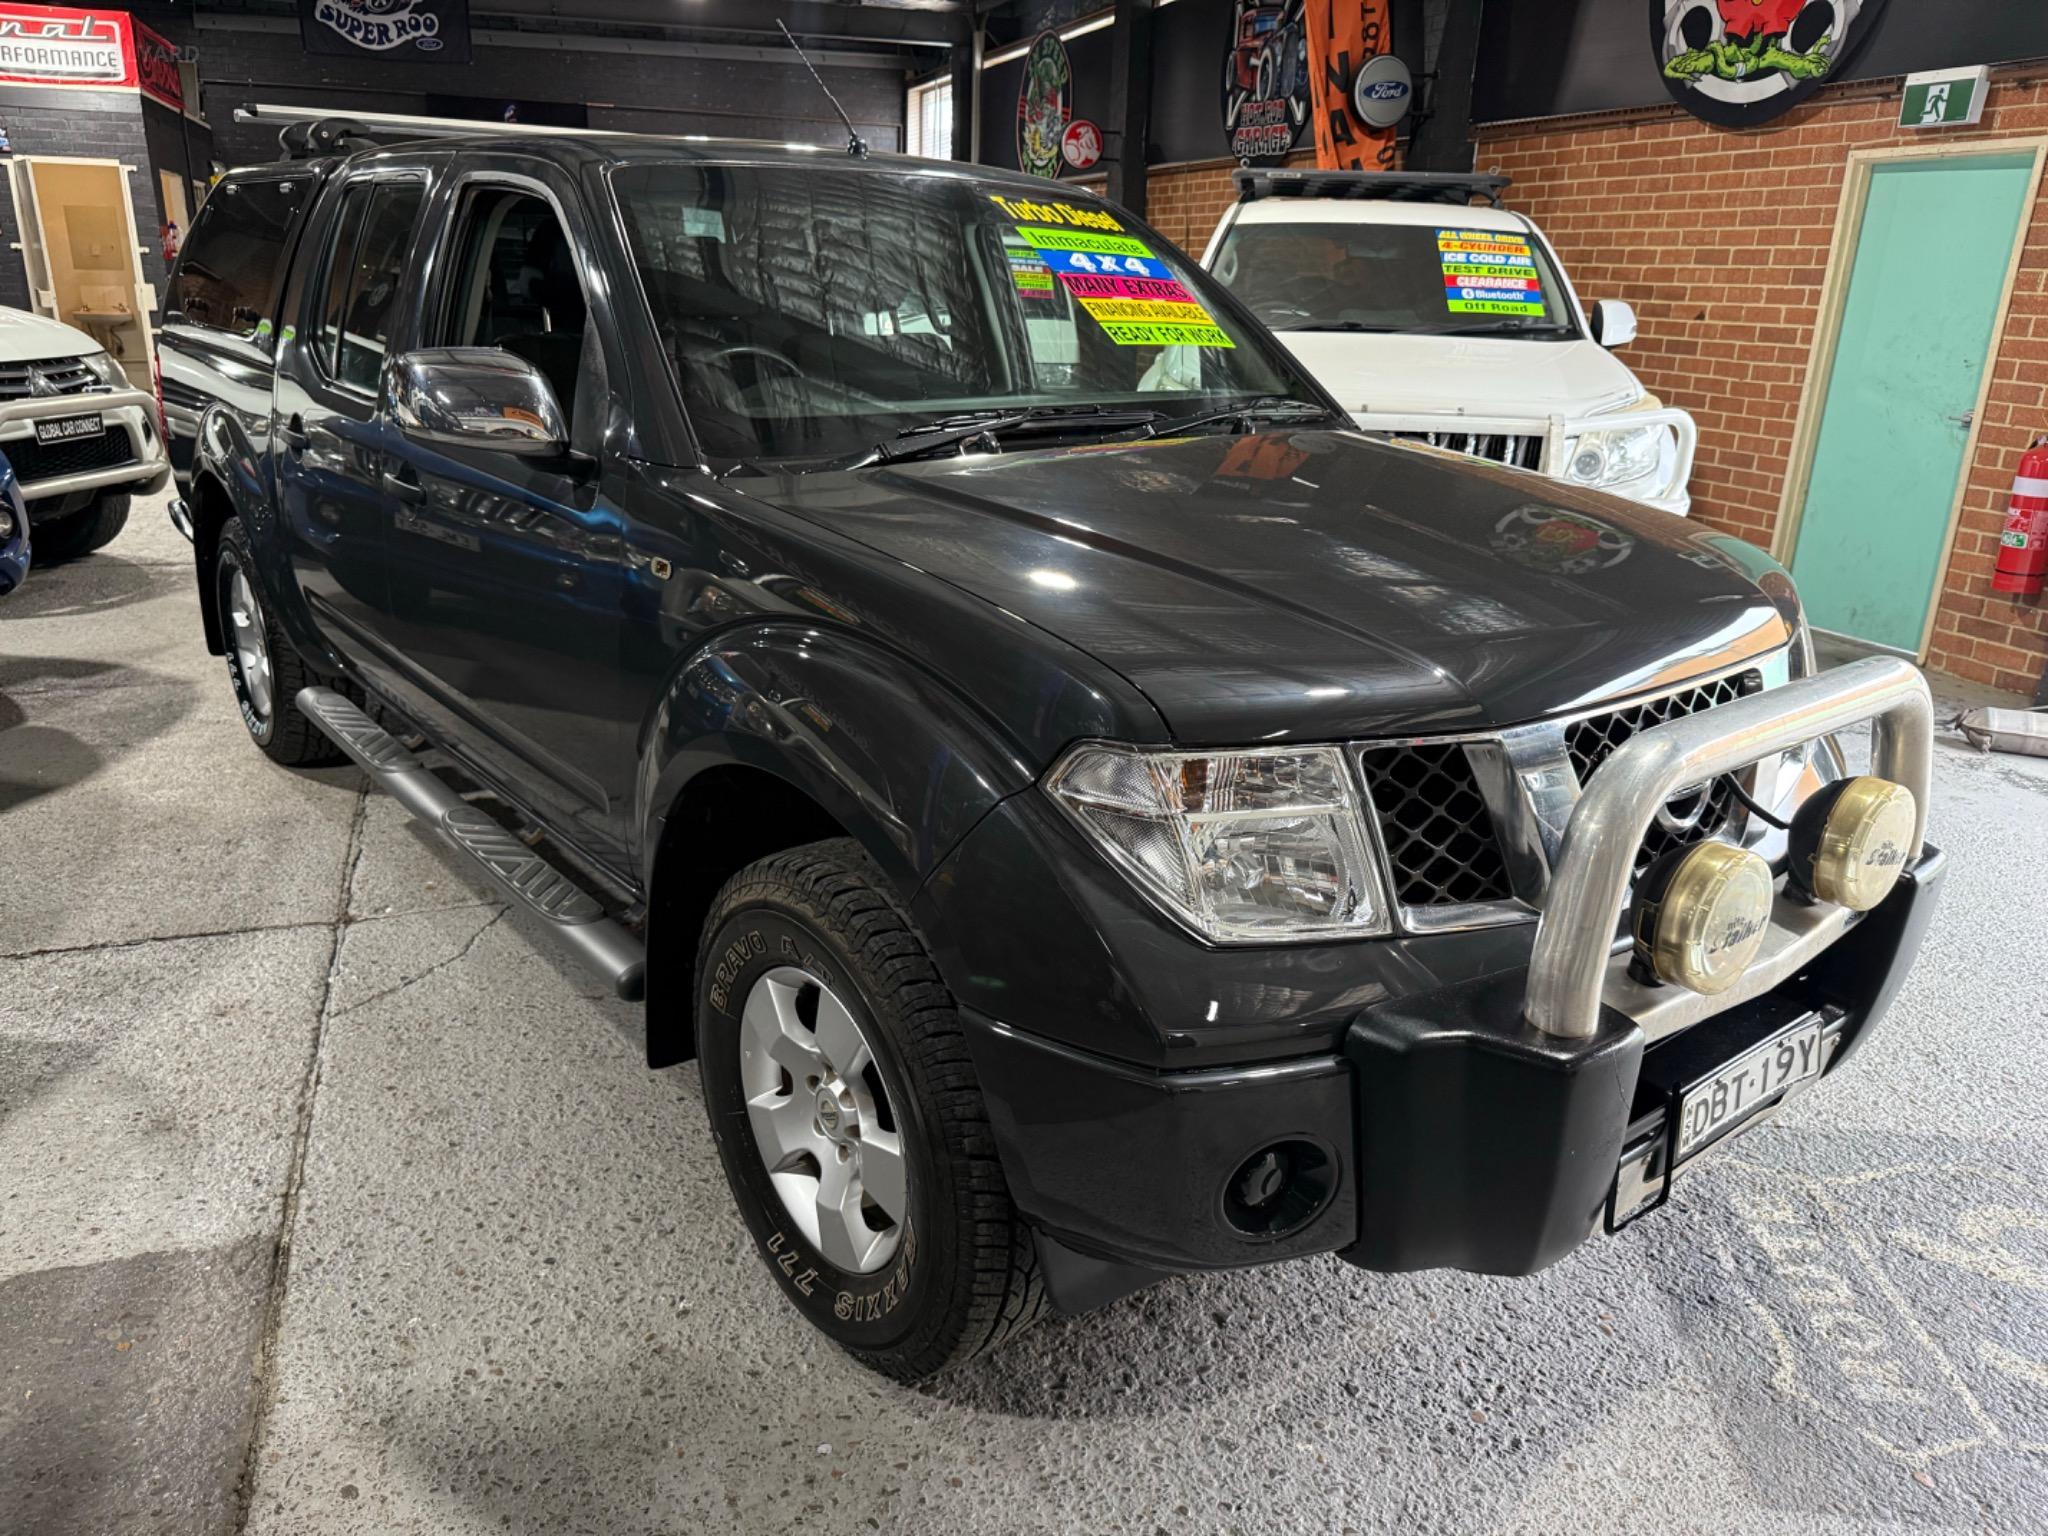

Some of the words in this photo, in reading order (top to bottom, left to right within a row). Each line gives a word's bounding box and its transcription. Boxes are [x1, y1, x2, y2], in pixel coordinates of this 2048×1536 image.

[319, 4, 393, 46] SUPER
[393, 15, 437, 39] ROO
[1371, 82, 1403, 99] Ford
[989, 195, 1064, 224] Turbo
[1052, 202, 1125, 232] Diesel
[1028, 231, 1144, 255] Immaculate
[1441, 242, 1525, 253] 4-CYLINDER
[1443, 252, 1467, 262] ICE
[1469, 254, 1507, 264] COLD
[1508, 256, 1533, 266] AIR
[1444, 265, 1482, 274] TEST
[1488, 267, 1534, 277] DRIVE
[1063, 276, 1120, 294] MANY
[1123, 279, 1193, 299] EXTRAS
[1456, 277, 1527, 289] CLEARANCE
[1148, 304, 1209, 321] AVAILABLE
[1491, 303, 1528, 312] Road
[1106, 326, 1159, 342] READY
[1157, 327, 1188, 342] FOR
[1186, 328, 1230, 344] WORK
[38, 422, 62, 439] GLOBAL
[63, 421, 75, 436] CAR
[75, 417, 101, 434] CONNECT
[710, 930, 768, 1013] BRAVO
